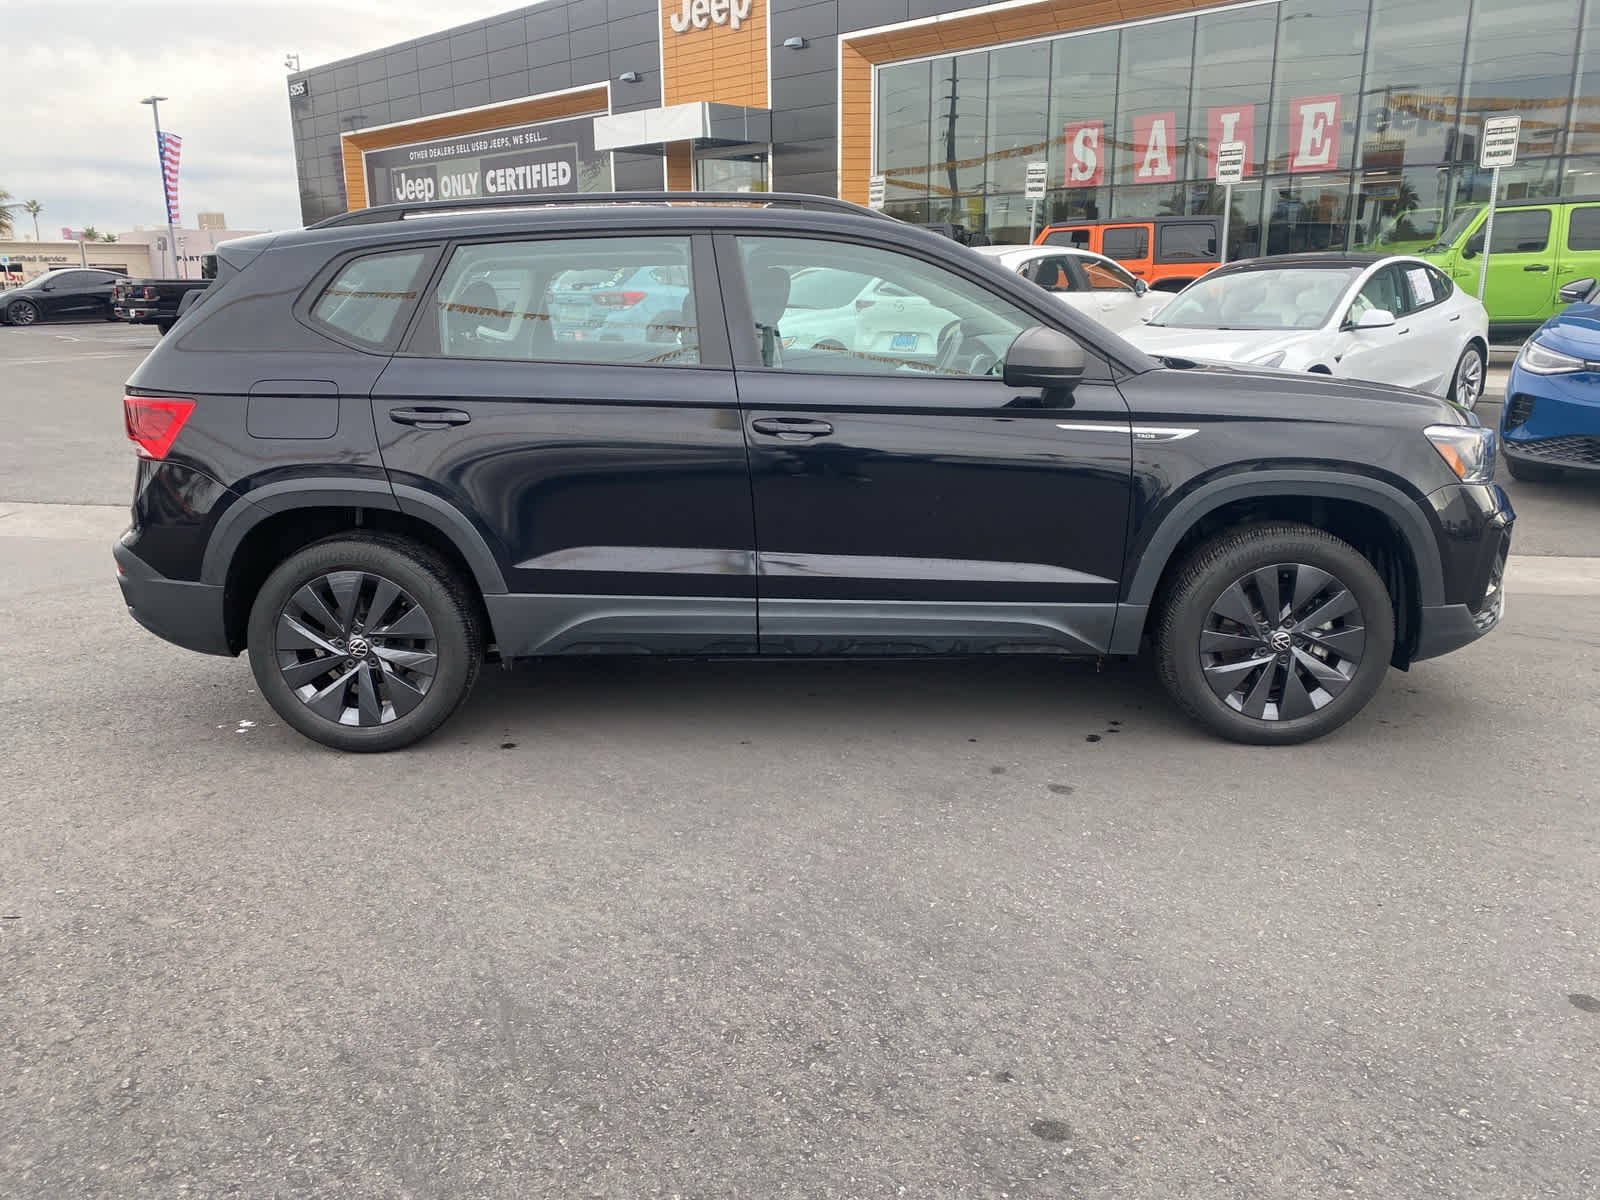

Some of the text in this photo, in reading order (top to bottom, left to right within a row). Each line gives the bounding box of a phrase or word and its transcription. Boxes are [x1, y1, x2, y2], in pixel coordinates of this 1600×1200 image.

[670, 0, 751, 32] Jeep
[409, 150, 428, 160] OTHER
[429, 145, 455, 158] DEALERS
[456, 143, 471, 154] SELL
[471, 141, 488, 151] USED
[489, 137, 511, 149] JEEPS,
[512, 135, 524, 145] WE
[1486, 150, 1512, 158] PARKING
[396, 161, 571, 202] Jeep ONLY CERTIFIED
